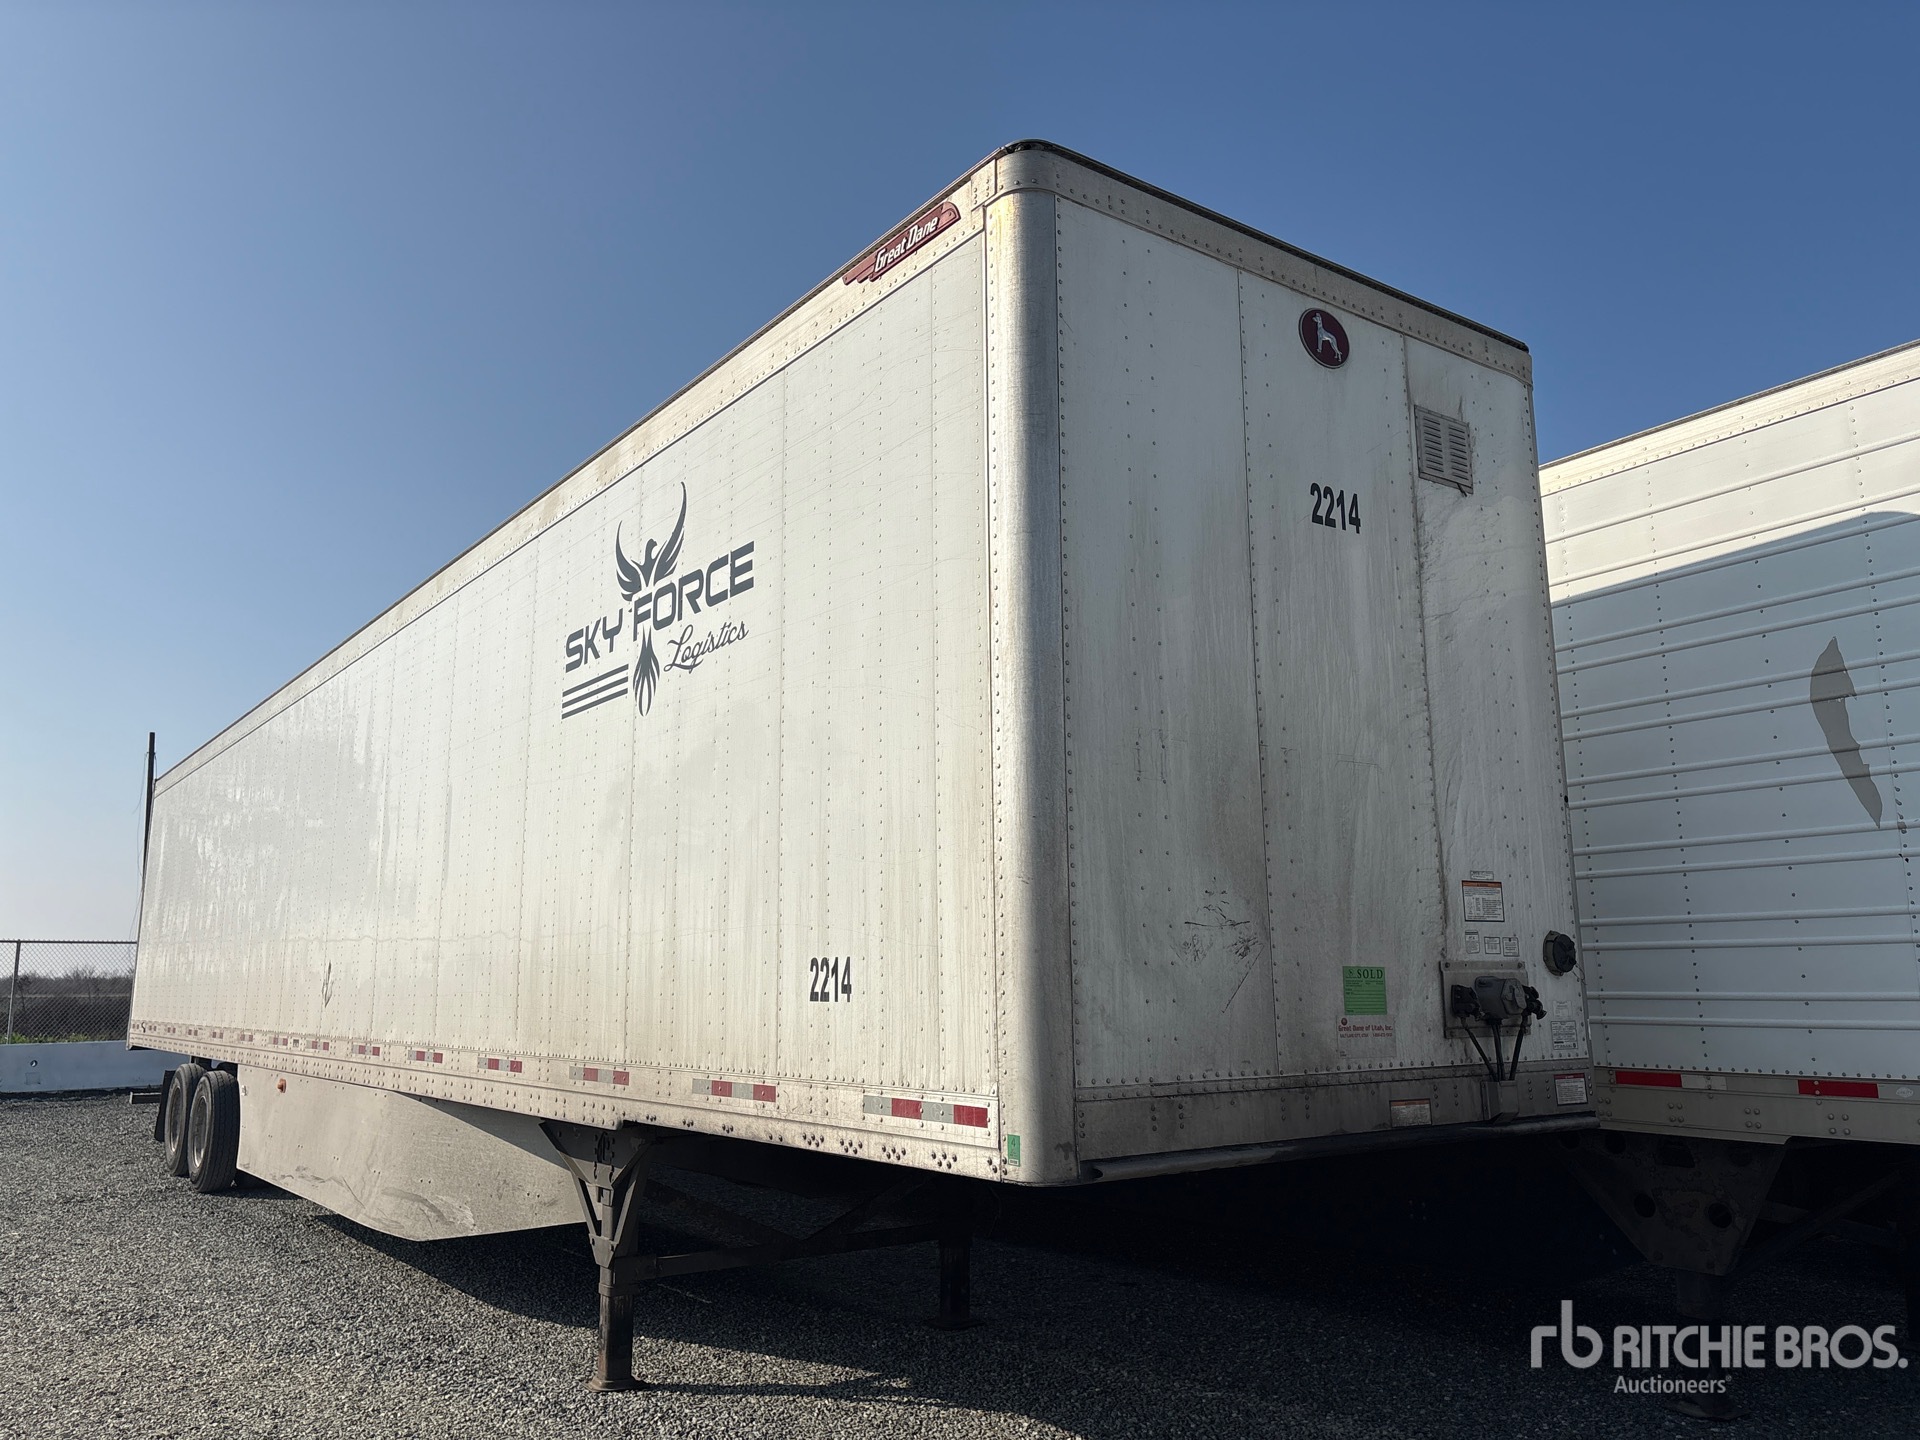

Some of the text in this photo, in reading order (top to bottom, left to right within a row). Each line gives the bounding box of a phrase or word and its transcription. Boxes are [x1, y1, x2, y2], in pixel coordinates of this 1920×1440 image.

[875, 217, 939, 273] Great Dane
[1310, 482, 1361, 534] 2214
[565, 540, 755, 674] SKY FORCE
[663, 620, 750, 674] Logistics
[809, 956, 852, 1003] 2214
[1357, 969, 1383, 979] SOLD
